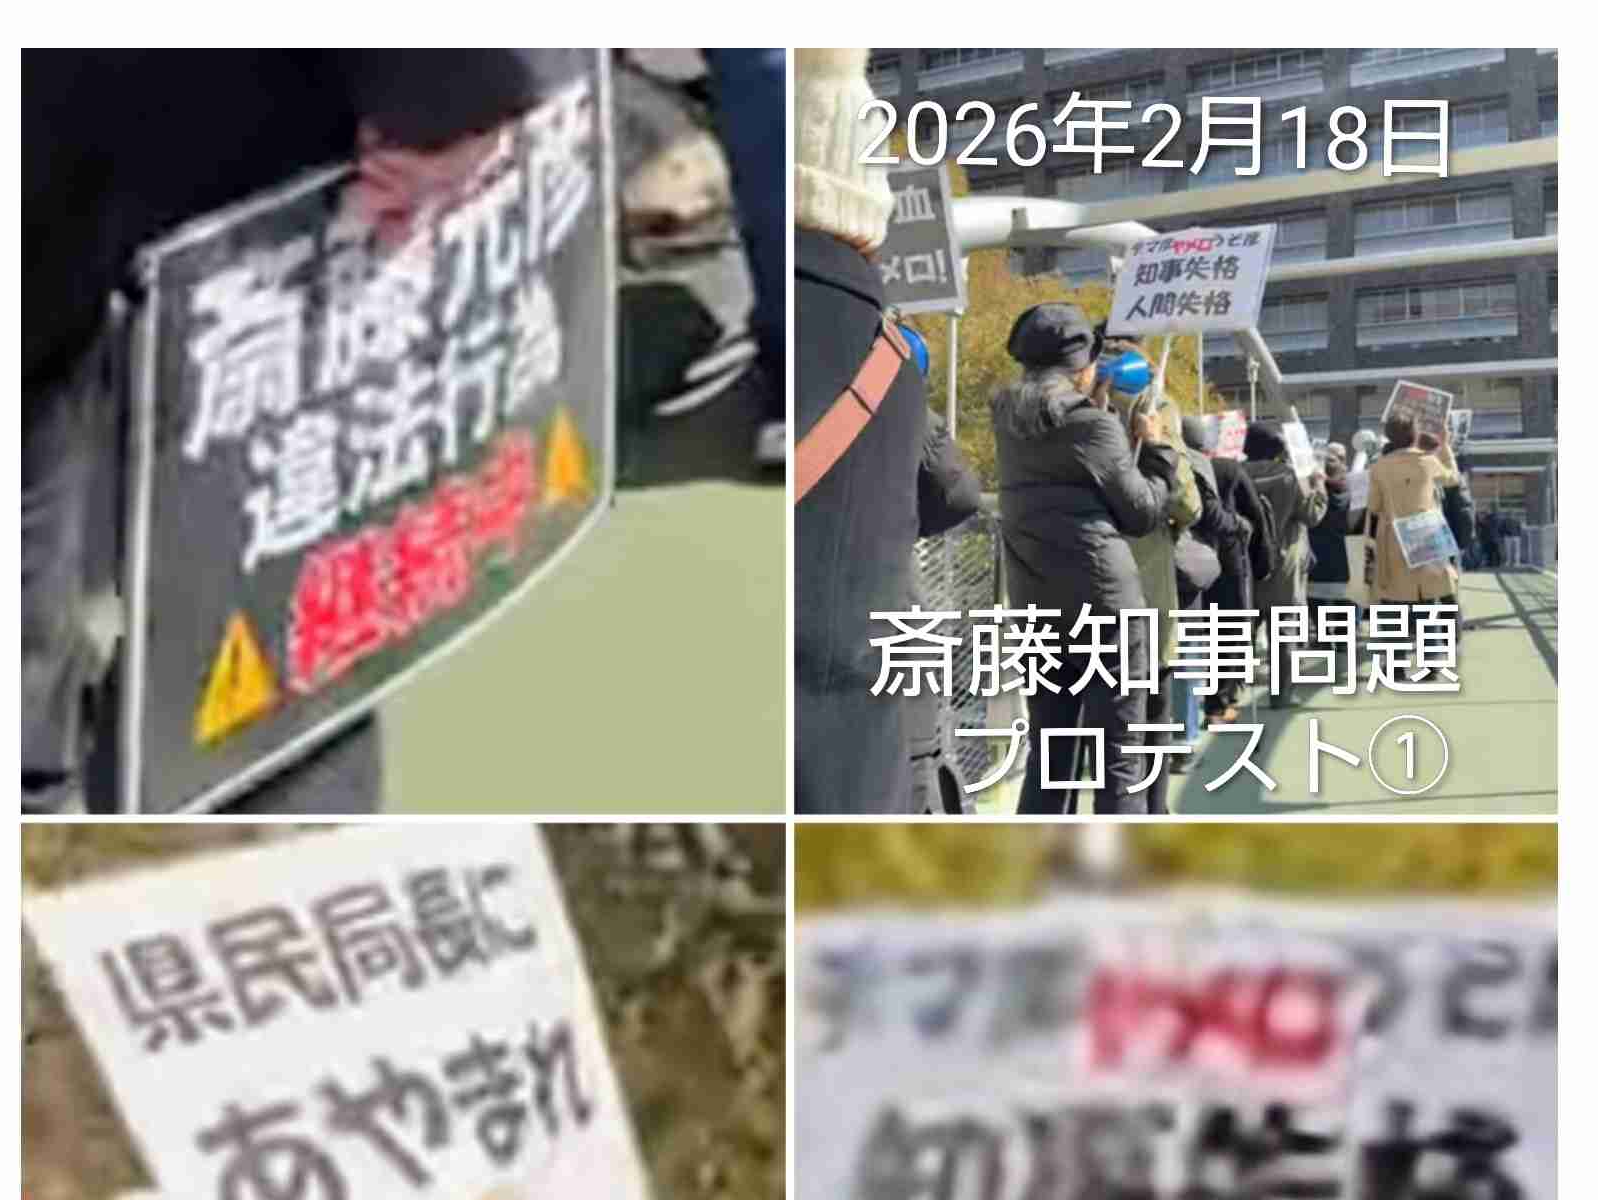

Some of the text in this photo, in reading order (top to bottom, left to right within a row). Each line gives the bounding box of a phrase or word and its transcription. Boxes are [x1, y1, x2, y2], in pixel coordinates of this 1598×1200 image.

[99, 862, 537, 1054] 県民局長に
